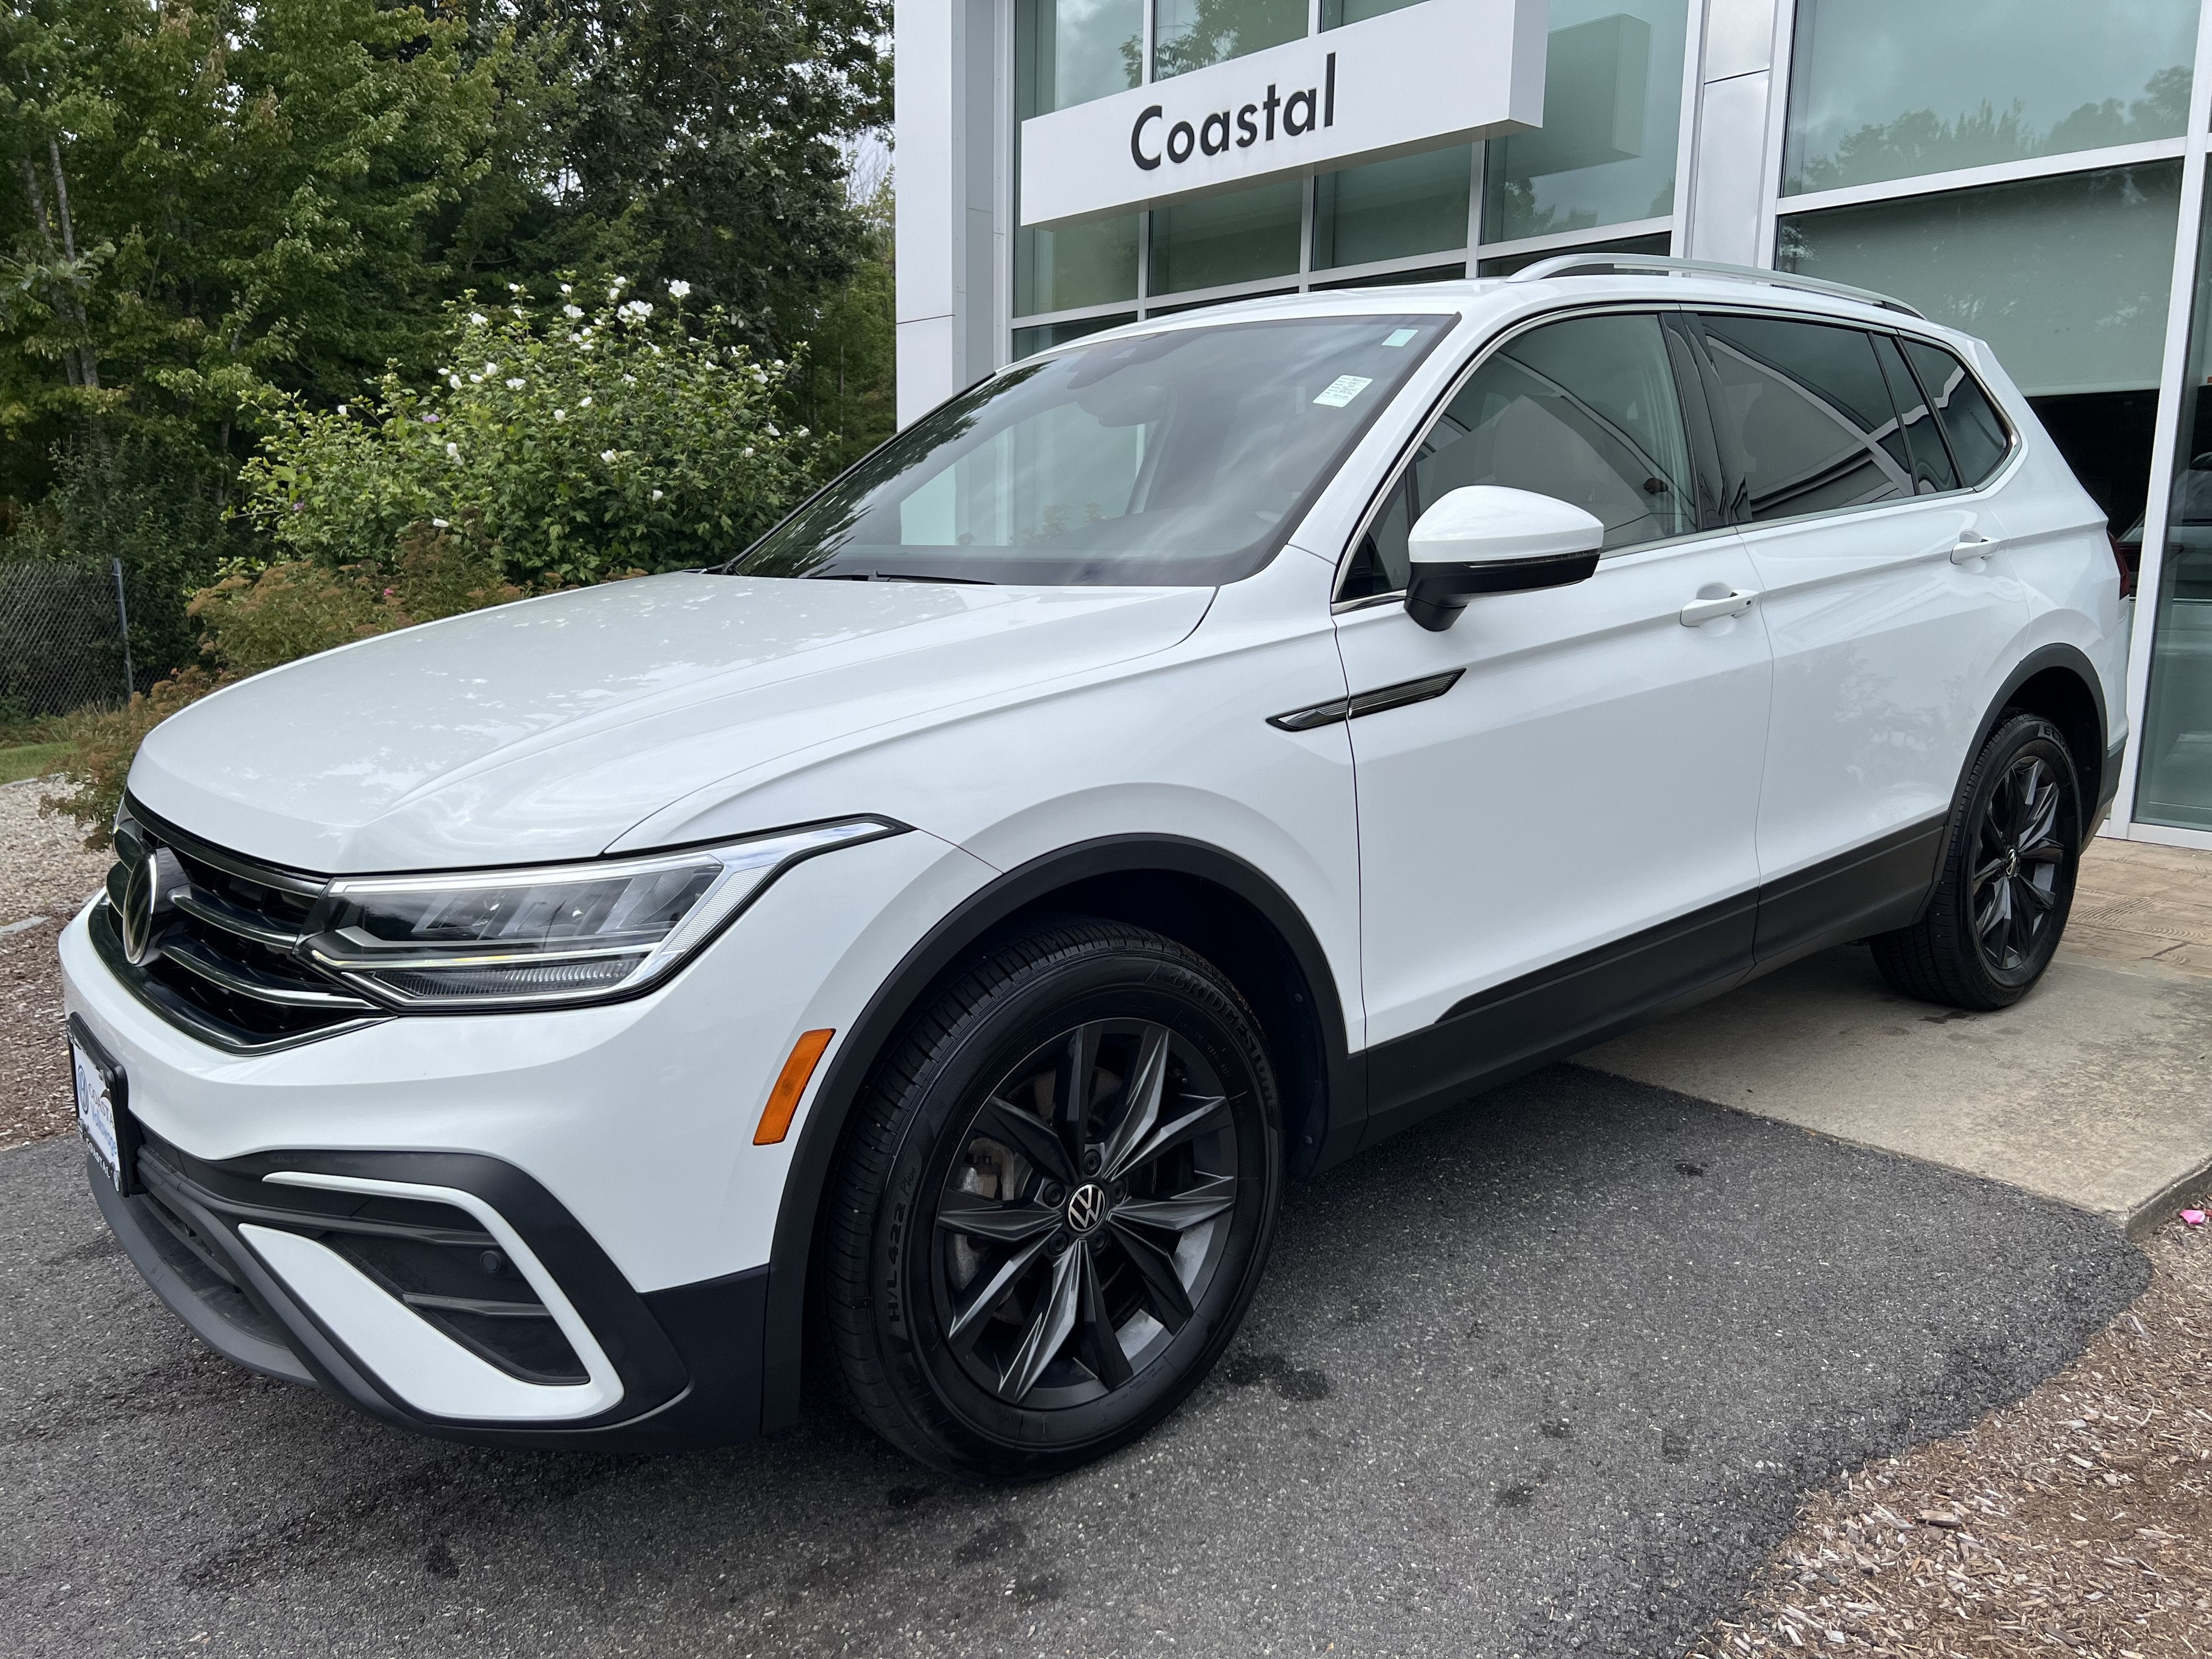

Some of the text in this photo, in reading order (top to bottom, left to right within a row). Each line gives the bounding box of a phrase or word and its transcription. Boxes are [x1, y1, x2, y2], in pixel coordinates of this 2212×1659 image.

[1131, 51, 1337, 171] Coastal
[1164, 968, 1279, 1115] BRIDGESTONE
[900, 1165, 916, 1196] Plus
